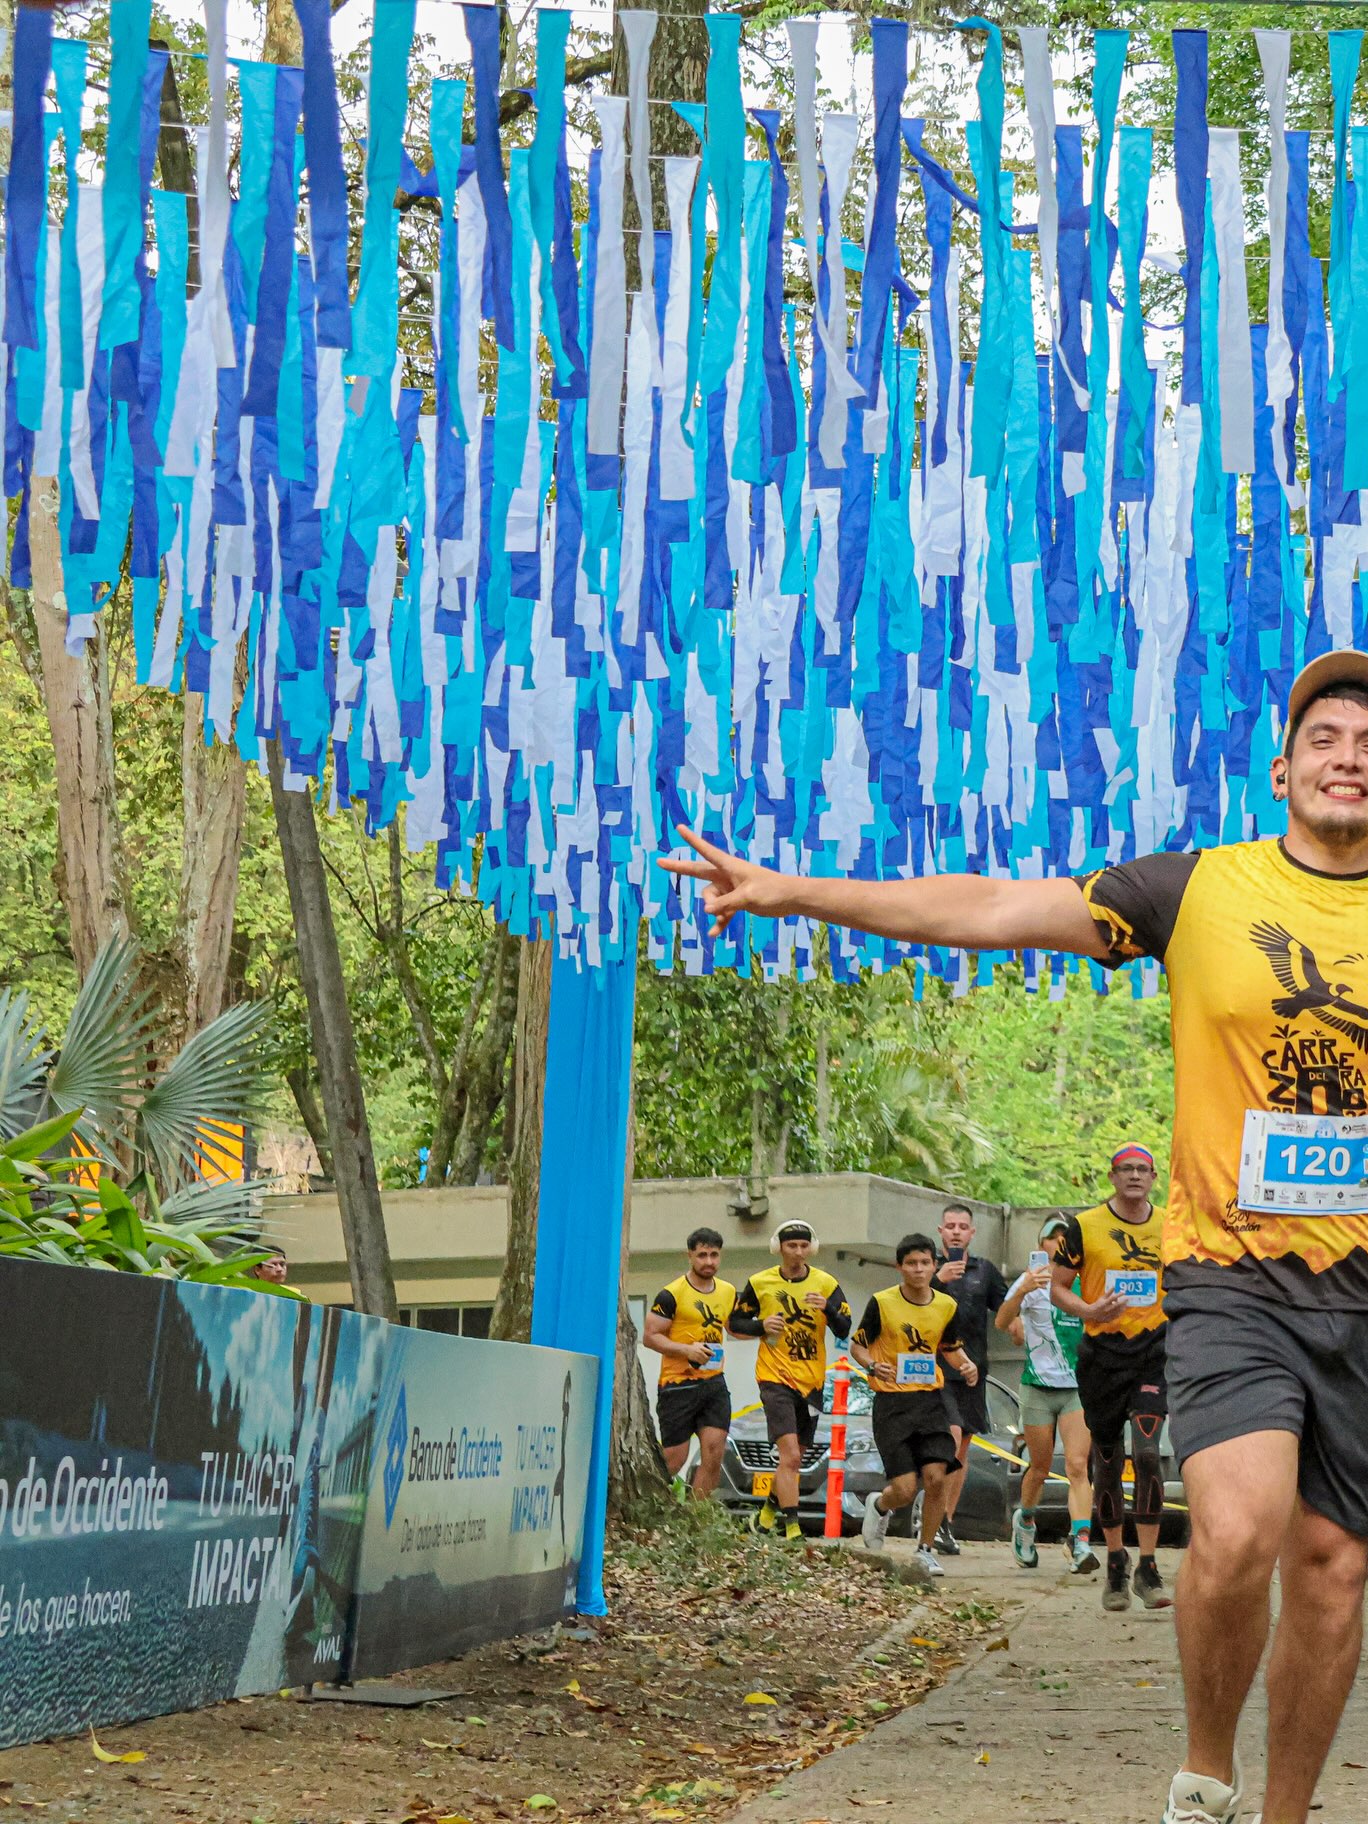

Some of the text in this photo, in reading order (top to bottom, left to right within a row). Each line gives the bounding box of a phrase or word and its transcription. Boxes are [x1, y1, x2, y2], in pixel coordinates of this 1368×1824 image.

[1280, 1144, 1351, 1177] 120
[1119, 1281, 1143, 1293] 903
[908, 1362, 929, 1373] 769
[408, 1426, 502, 1482] Banco de Occidente
[12, 1457, 47, 1537] de
[52, 1456, 169, 1535] Occidente
[199, 1452, 230, 1518] TU
[755, 1477, 773, 1490] LS
[14, 1582, 42, 1636] los
[44, 1594, 77, 1644] que
[79, 1576, 131, 1628] hacen.
[314, 1634, 341, 1664] AVAL
